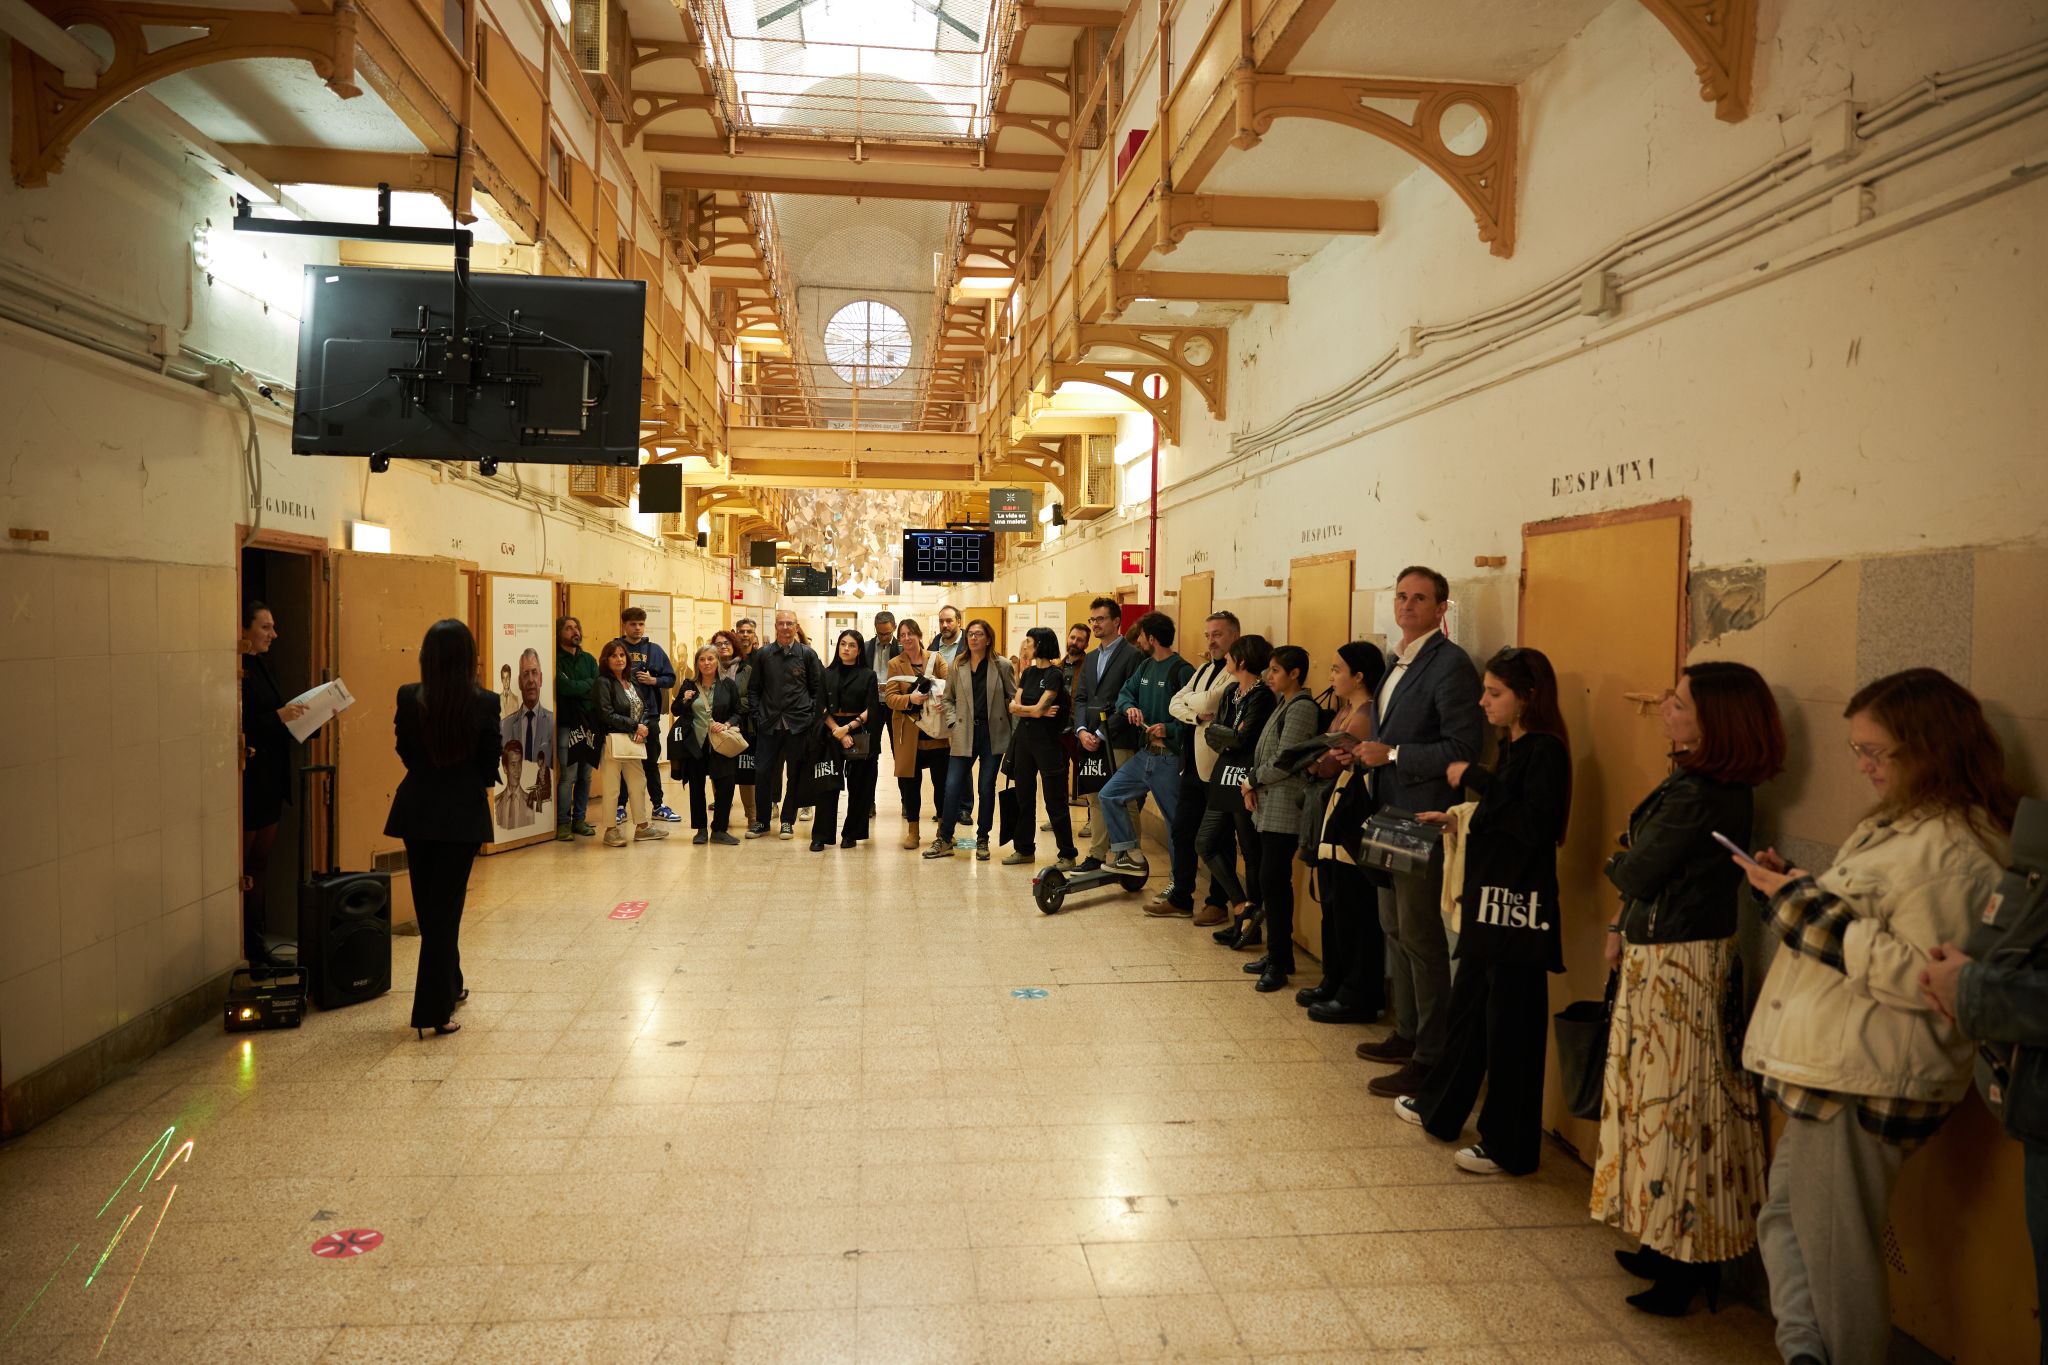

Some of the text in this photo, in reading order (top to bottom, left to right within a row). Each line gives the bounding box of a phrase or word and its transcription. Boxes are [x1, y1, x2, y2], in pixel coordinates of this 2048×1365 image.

[250, 494, 316, 521] GADERIA
[738, 754, 755, 769] his
[814, 759, 839, 779] hist.
[1220, 765, 1248, 786] his
[1490, 886, 1525, 905] The
[1476, 886, 1551, 931] hist.
